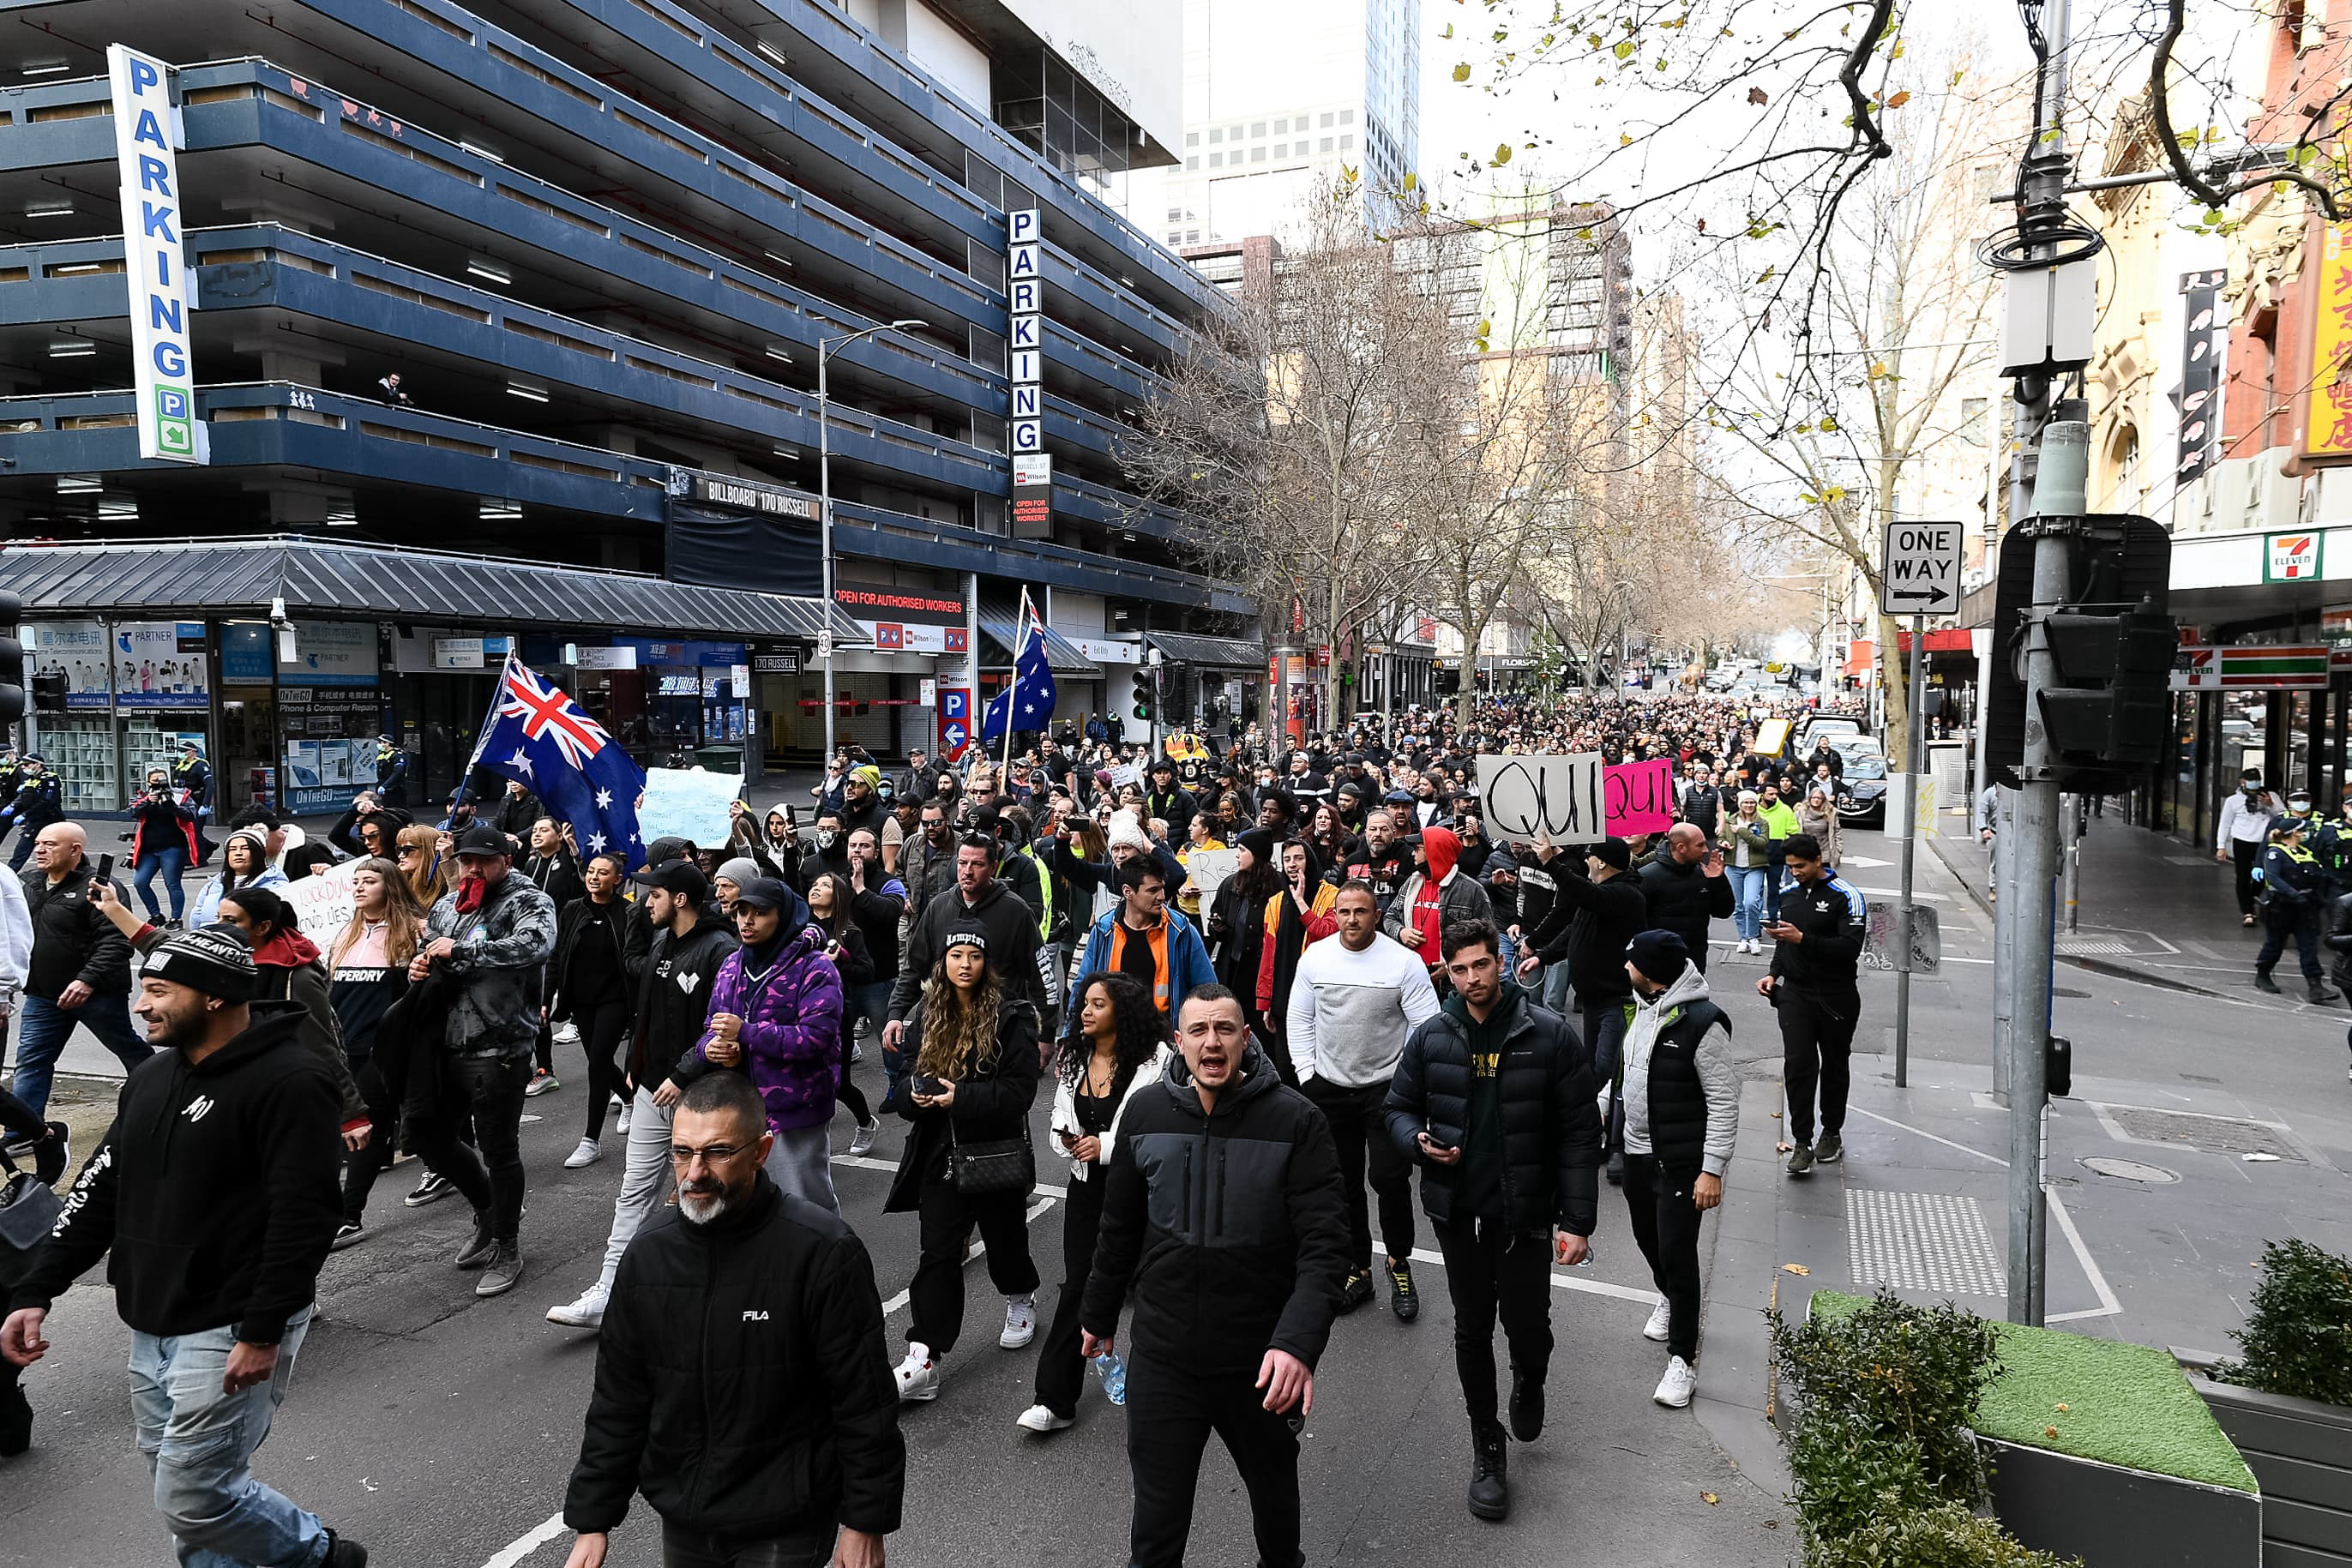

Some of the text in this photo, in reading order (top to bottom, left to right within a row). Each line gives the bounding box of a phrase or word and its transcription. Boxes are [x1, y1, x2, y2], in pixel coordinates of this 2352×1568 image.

[129, 57, 186, 377] PARKING
[1014, 213, 1036, 448] PARKING
[708, 481, 810, 518] BILLBOARD 170 RUSSELL
[1014, 507, 1050, 515] AUTHORISED
[1899, 531, 1951, 551] ONE
[1893, 559, 1953, 580] WAY
[835, 590, 962, 614] OPEN FOR AUTHORISED WORKERS
[135, 630, 172, 642] PARTNER
[819, 638, 830, 648] 40
[755, 658, 797, 669] 170 RUSSELL
[280, 703, 378, 713] Phone & Computer Repairs
[947, 694, 962, 716] P
[1486, 760, 1598, 838] QUI
[1604, 767, 1667, 820] QUI
[334, 970, 386, 982] UPERDRY
[743, 1310, 769, 1322] FILA
